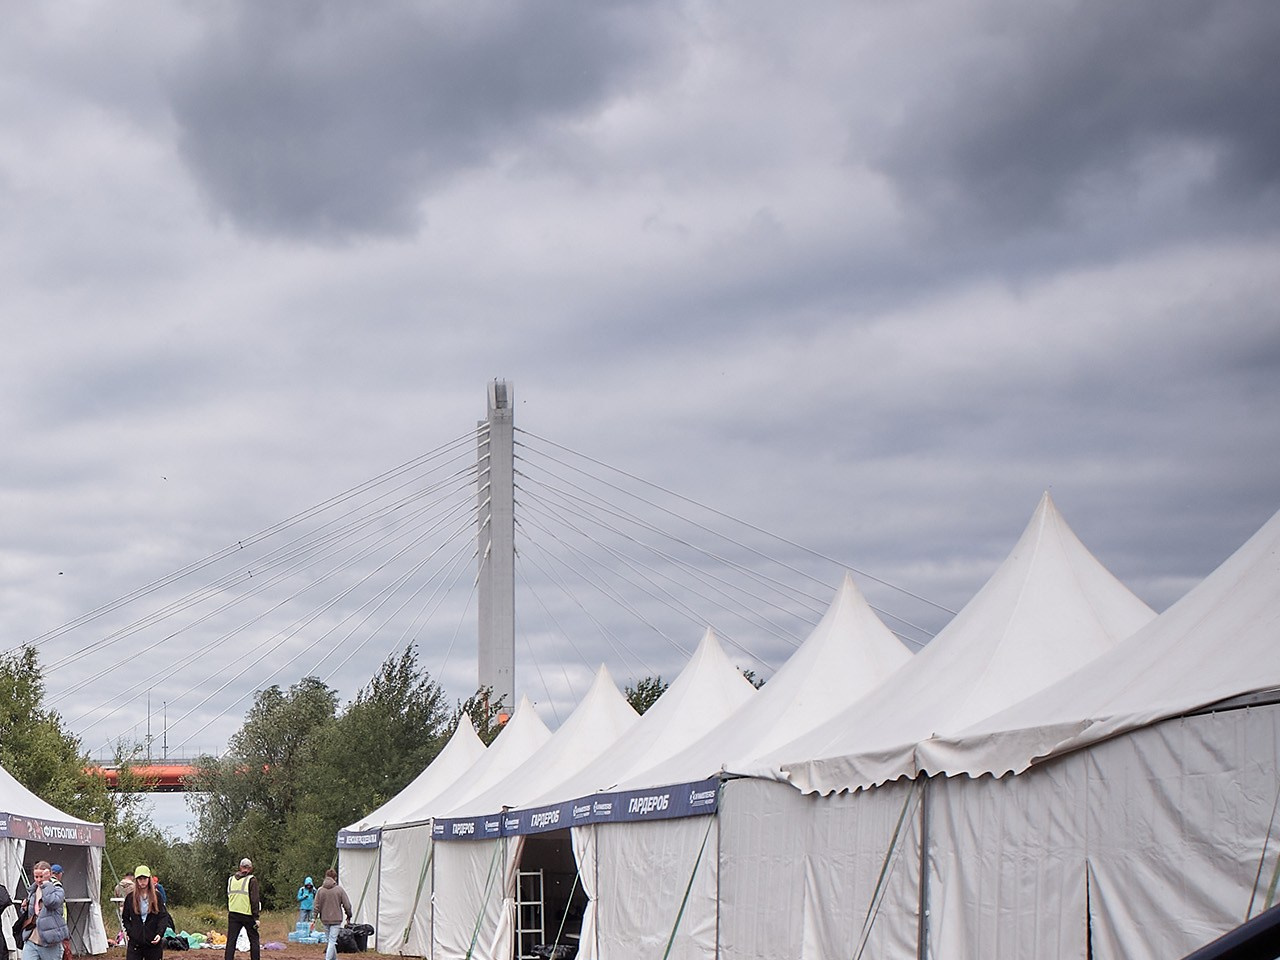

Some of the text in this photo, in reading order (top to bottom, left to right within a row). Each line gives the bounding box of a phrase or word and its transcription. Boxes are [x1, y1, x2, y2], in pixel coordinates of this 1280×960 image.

[628, 794, 670, 815] ГАРДЕРОБ
[531, 810, 560, 828] ГАРДЕРОБ
[43, 825, 77, 839] ФУТБОЛКИ
